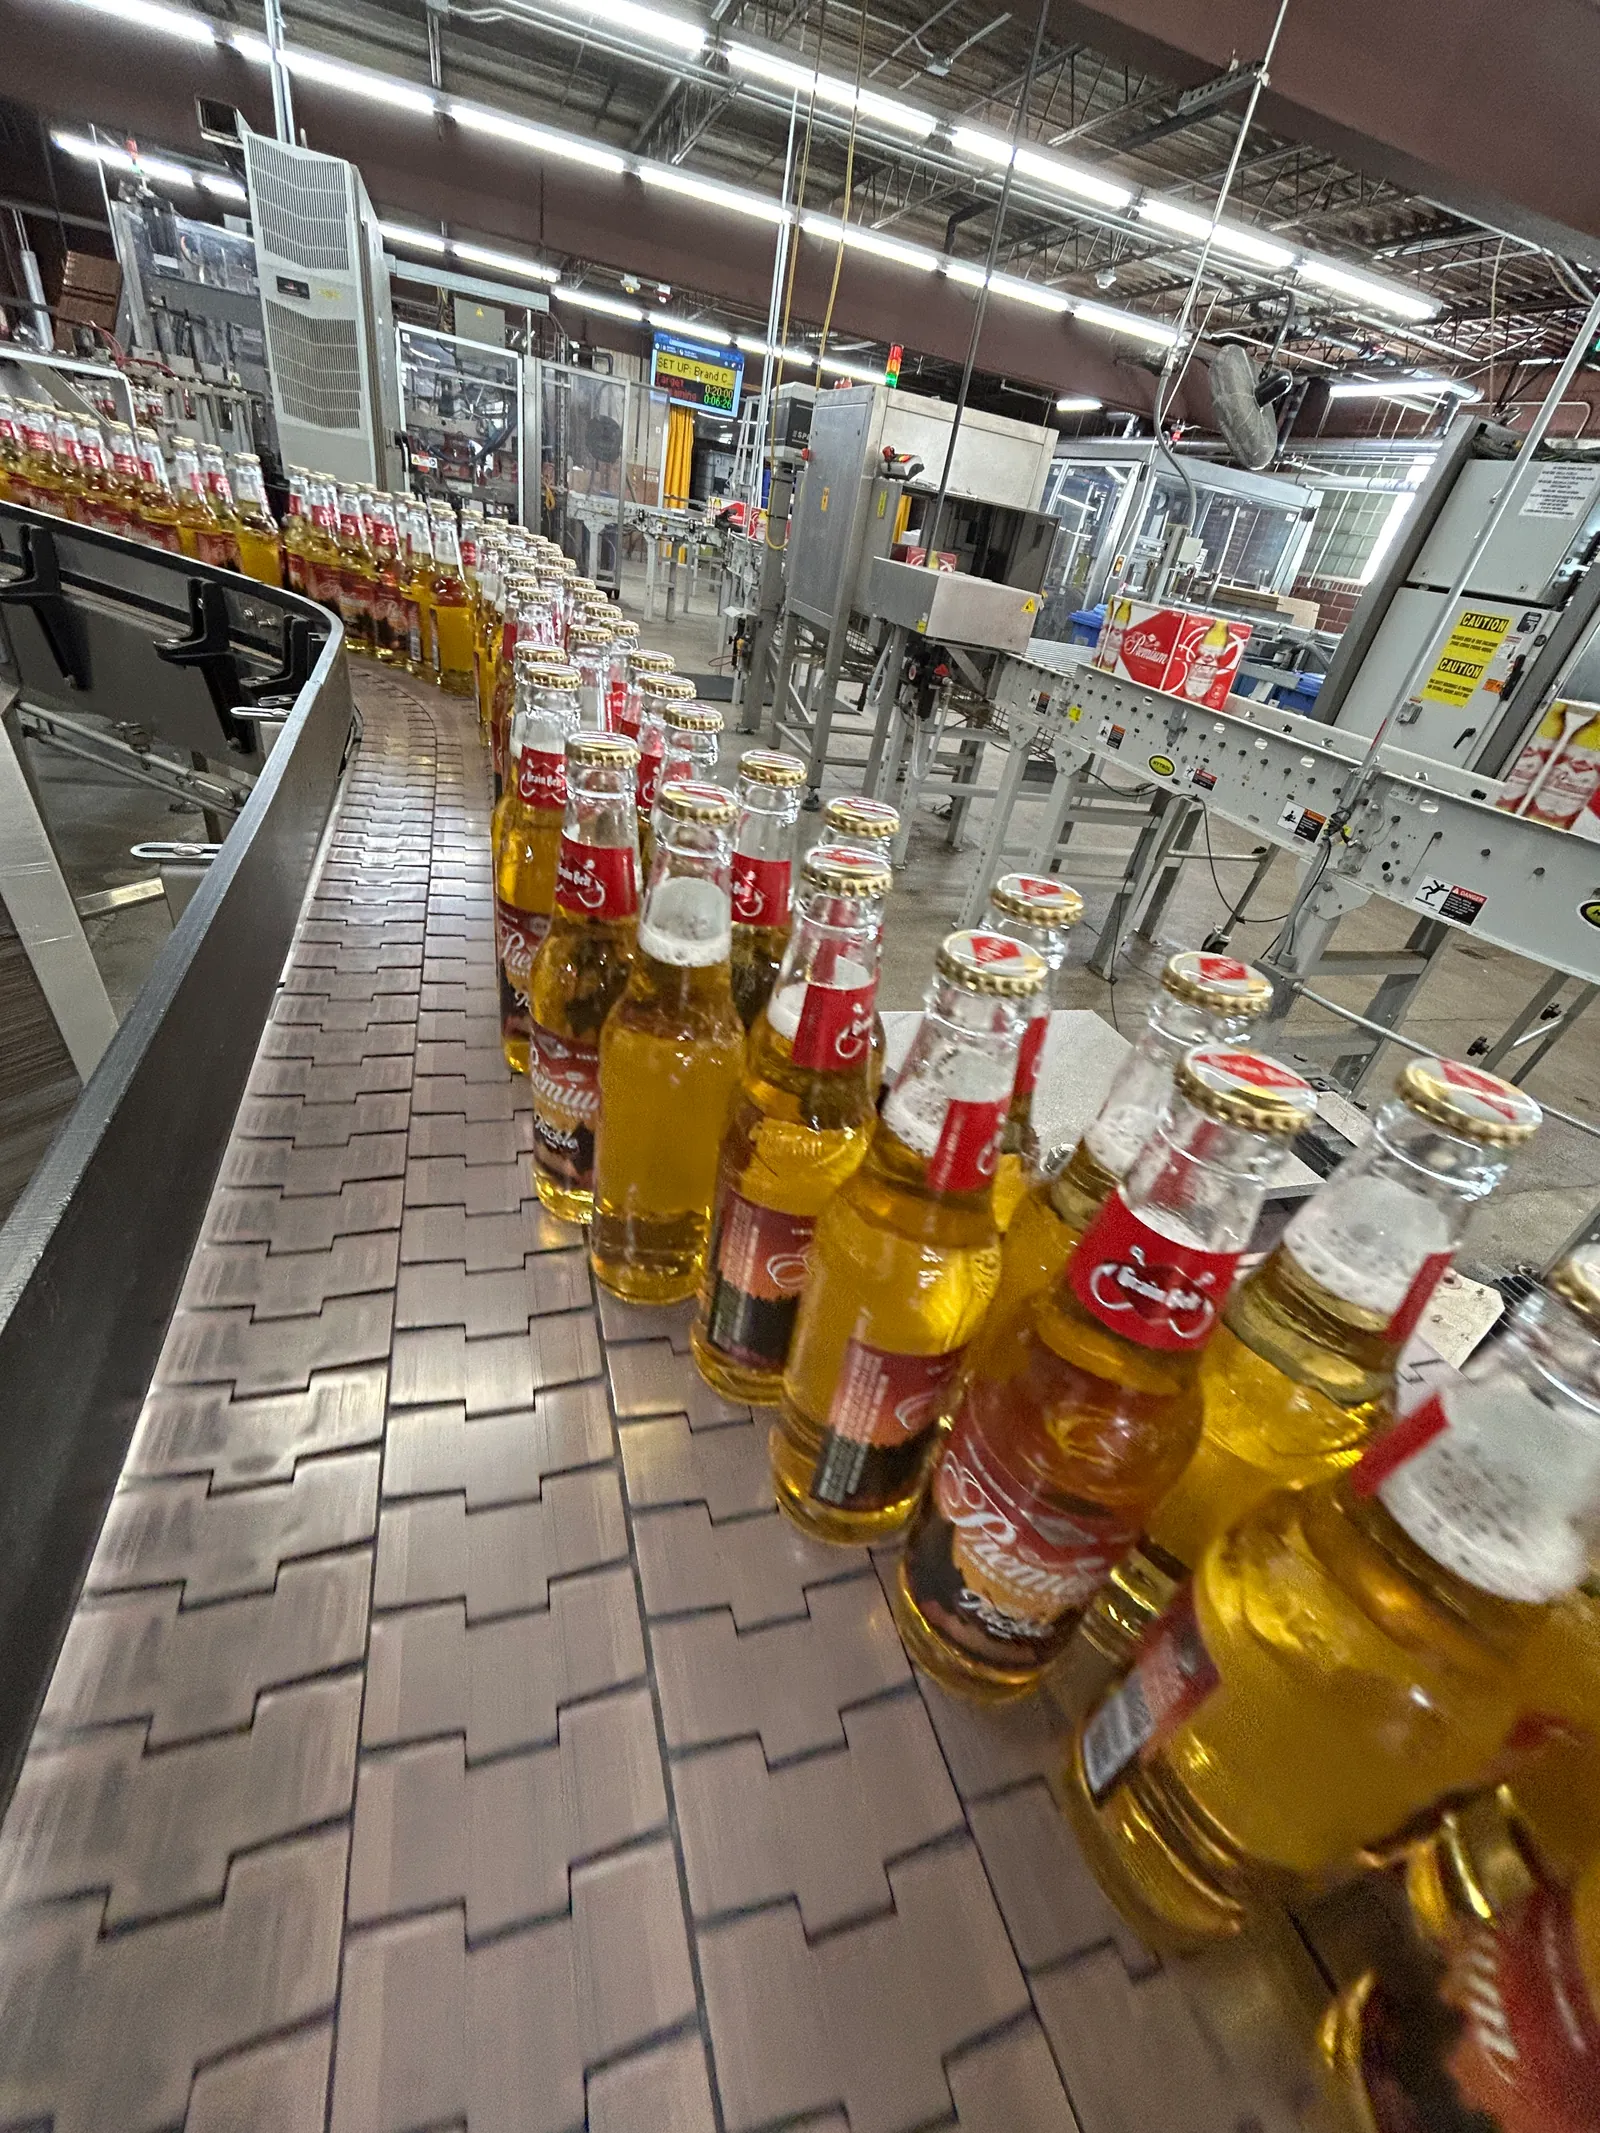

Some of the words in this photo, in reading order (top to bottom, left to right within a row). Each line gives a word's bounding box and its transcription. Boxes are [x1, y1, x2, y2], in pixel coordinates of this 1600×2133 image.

[657, 357, 674, 369] SET
[676, 362, 692, 373] UP:
[694, 366, 719, 381] Brand
[705, 384, 734, 399] 0:20:00
[703, 394, 732, 409] 0:06:26
[1461, 614, 1508, 632] CAUTION
[1440, 659, 1483, 678] CAUTION
[1460, 890, 1486, 904] DANGER
